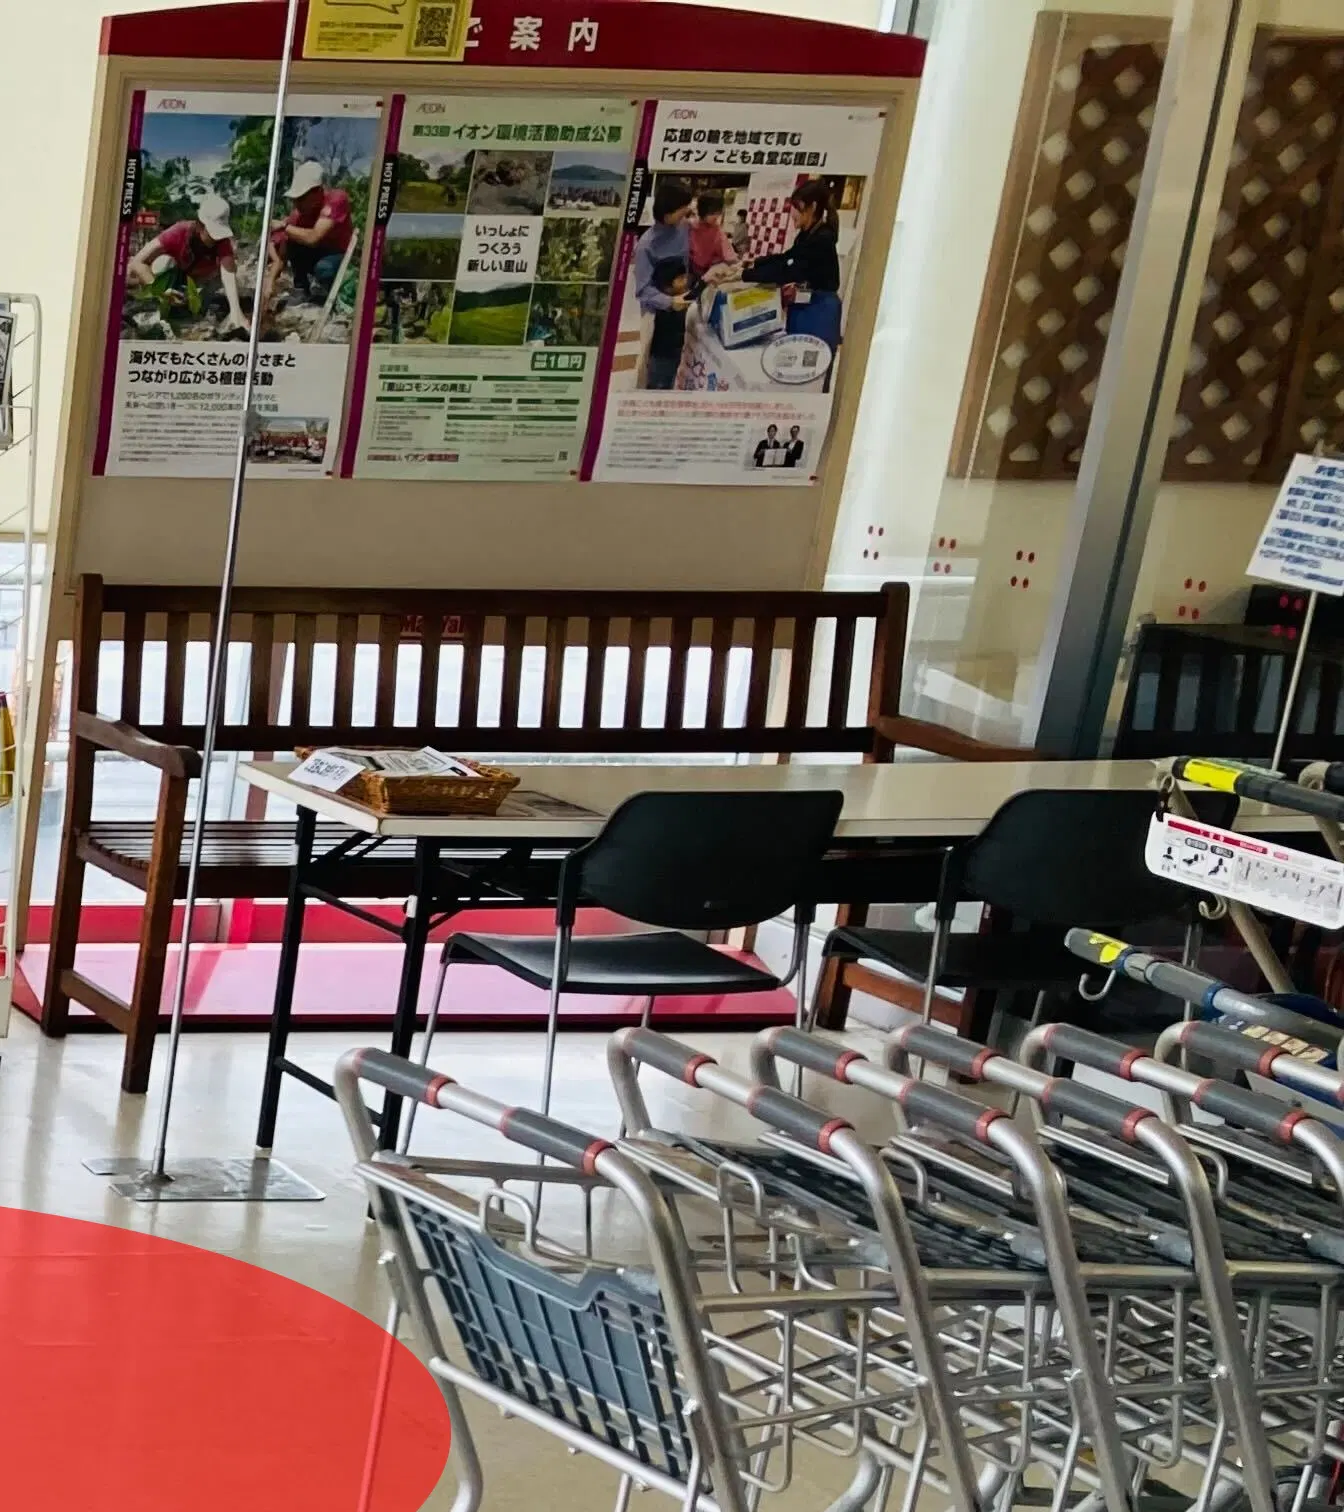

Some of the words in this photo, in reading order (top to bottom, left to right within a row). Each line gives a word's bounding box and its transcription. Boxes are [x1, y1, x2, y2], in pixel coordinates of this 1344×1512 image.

[453, 123, 623, 143] イオン環境活動助成公募
[663, 128, 802, 147] 応援の輪を地域で育む
[125, 158, 137, 182] HOT
[382, 162, 394, 184] HOT
[633, 167, 644, 189] HOT
[122, 183, 135, 216] PRESS
[378, 185, 390, 219] PRESS
[627, 190, 640, 224] PRESS
[475, 225, 529, 237] いっしょに
[478, 243, 522, 255] つくろう
[467, 259, 528, 273] 新しい里山
